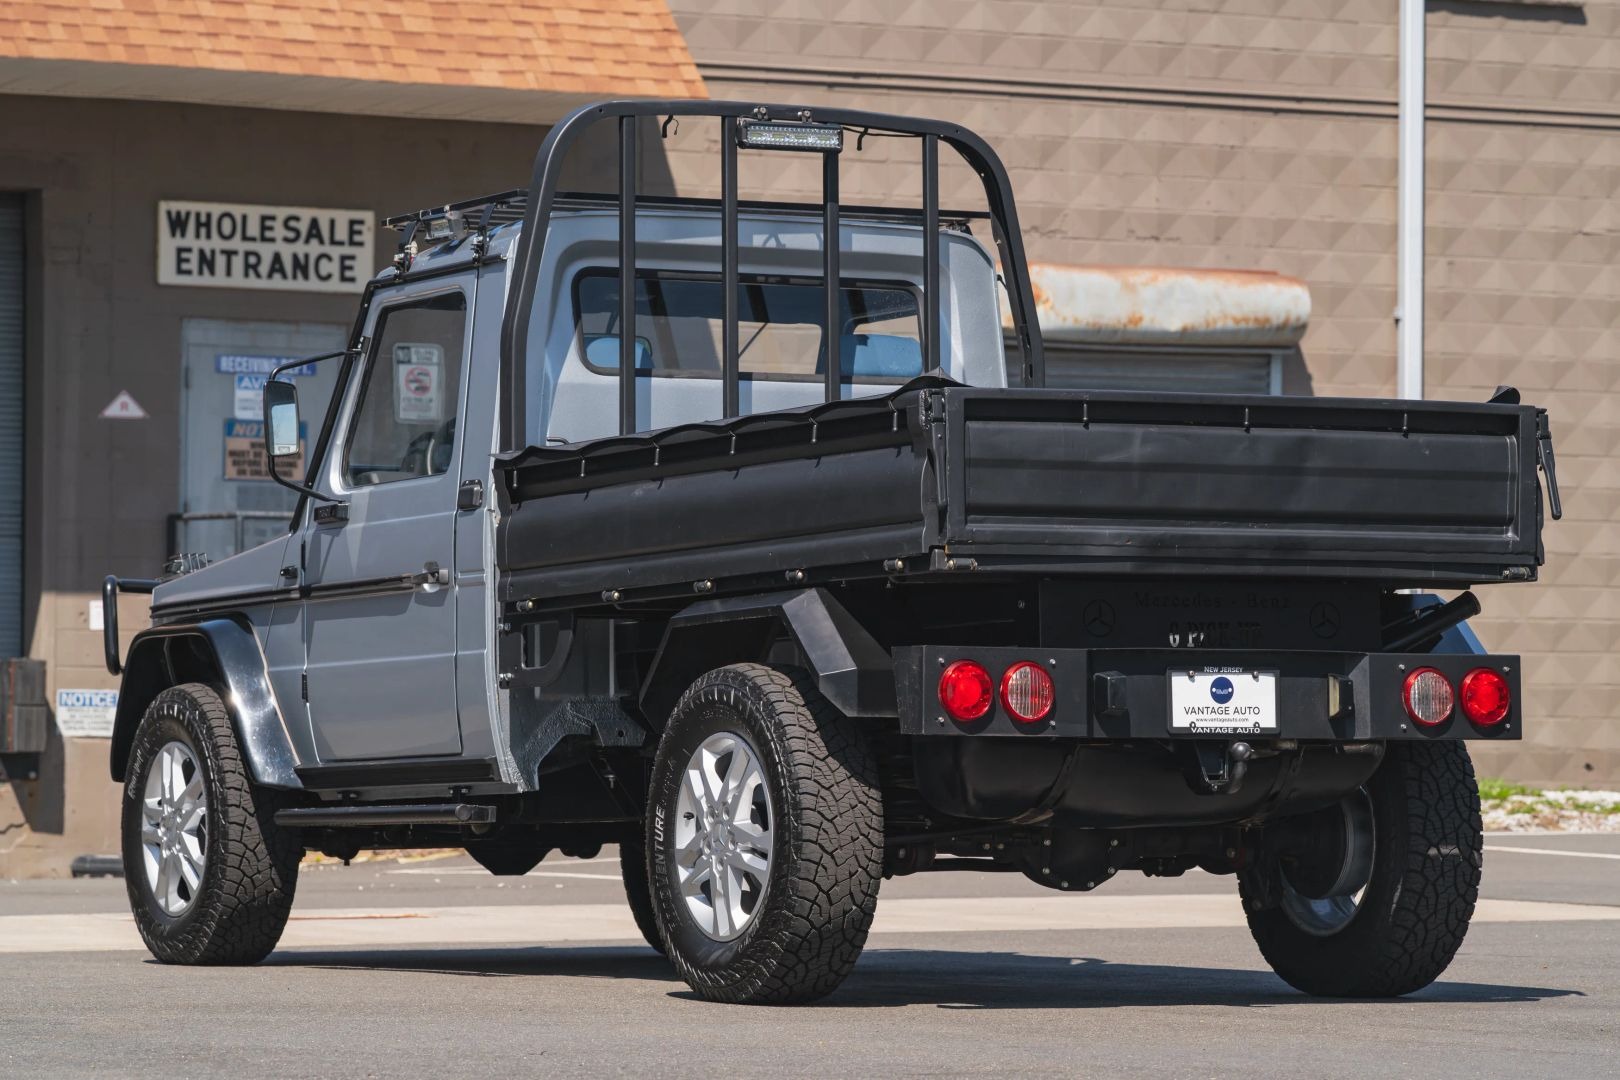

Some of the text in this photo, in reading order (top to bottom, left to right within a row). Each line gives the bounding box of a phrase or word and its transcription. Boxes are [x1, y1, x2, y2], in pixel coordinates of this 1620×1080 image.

[166, 209, 365, 247] WHOLESALE
[176, 247, 357, 283] ENTRANCE
[61, 692, 115, 707] NOTICE
[1184, 706, 1261, 716] VANTAGE AUTO
